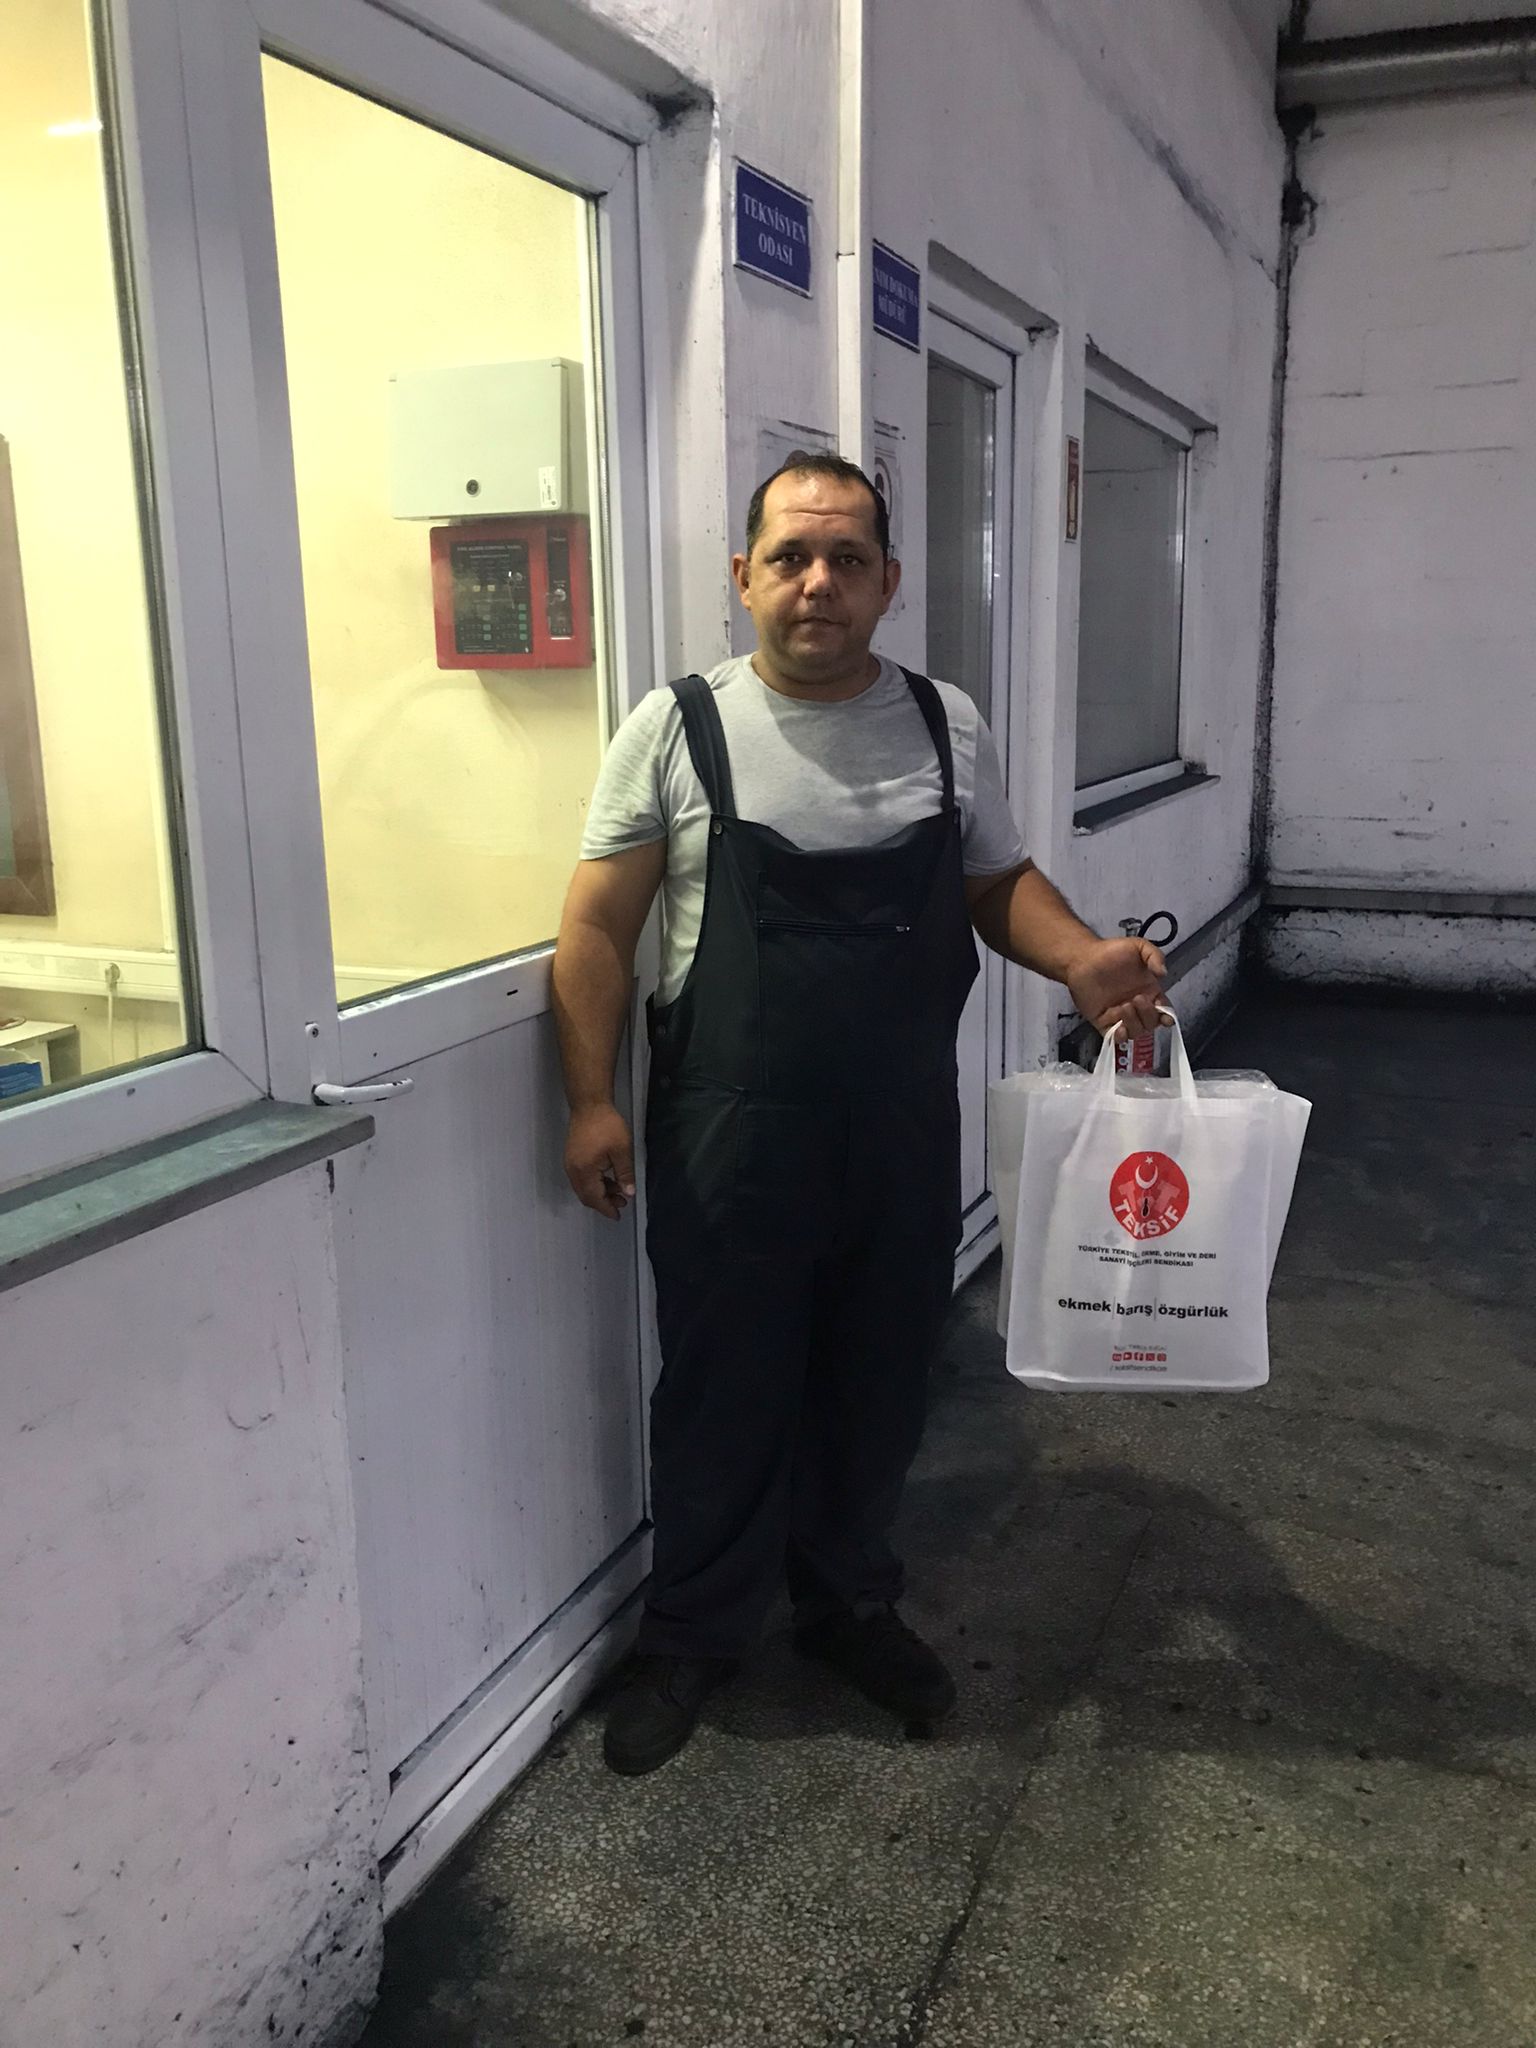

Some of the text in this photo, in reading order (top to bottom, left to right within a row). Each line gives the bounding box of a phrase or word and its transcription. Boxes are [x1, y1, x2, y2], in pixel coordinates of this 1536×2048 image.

[742, 193, 807, 245] TEKNİSYEN
[758, 232, 793, 266] ODASI
[1077, 1244, 1110, 1254] TÜRKİYE
[1099, 1256, 1126, 1264] SANAYİ
[1153, 1258, 1194, 1267] SENDİKASI
[1058, 1297, 1229, 1319] ekmek barış özgürlük
